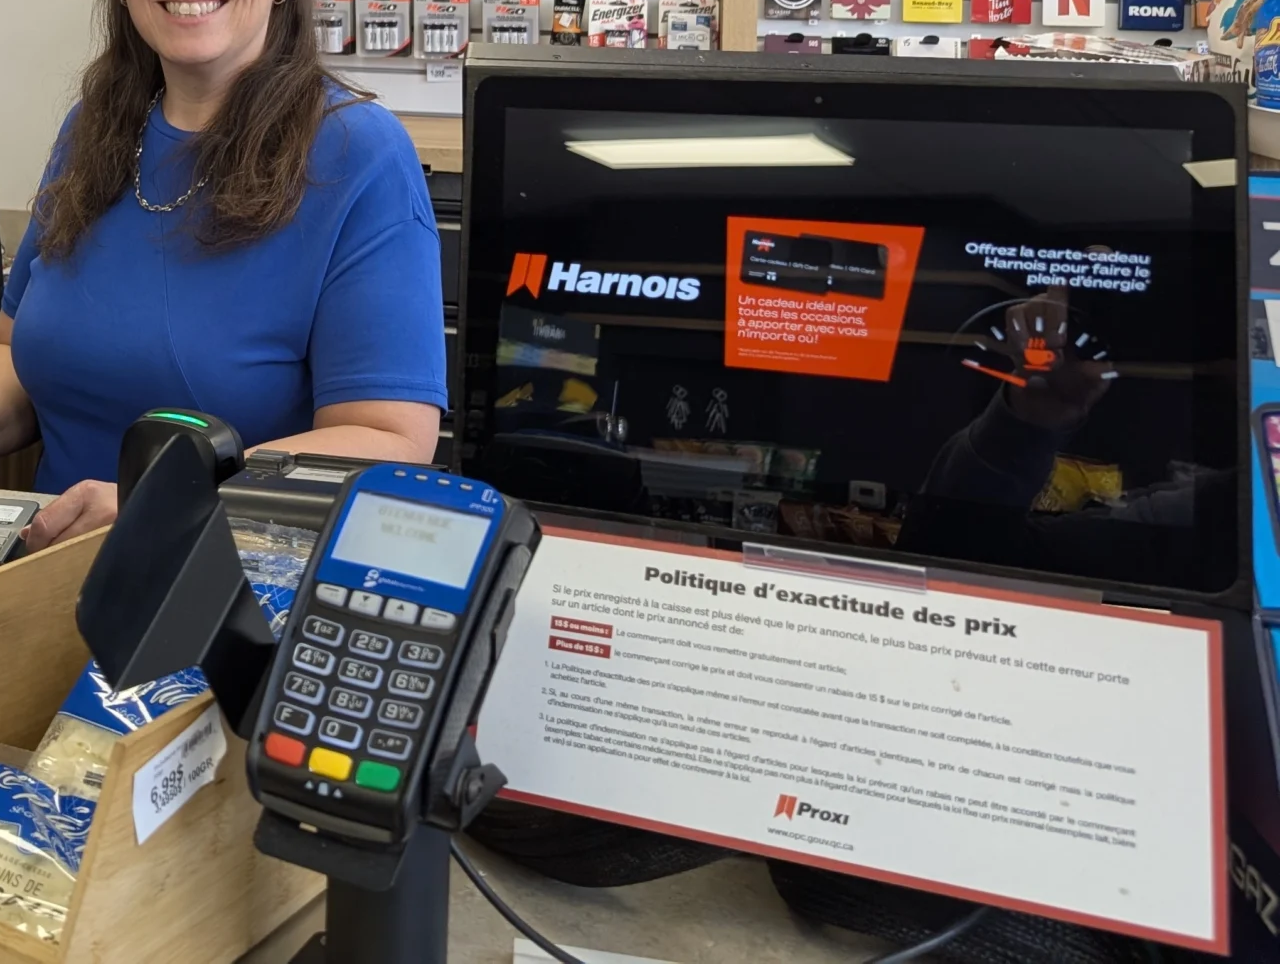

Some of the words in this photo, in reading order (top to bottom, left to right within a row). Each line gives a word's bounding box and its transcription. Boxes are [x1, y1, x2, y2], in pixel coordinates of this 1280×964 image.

[591, 3, 645, 21] Energizer
[1128, 5, 1177, 18] RONA
[965, 242, 1017, 257] Offrez
[1020, 245, 1034, 258] la
[1037, 247, 1152, 265] carte-cadeau
[984, 256, 1047, 271] Harnois
[1049, 261, 1089, 274] pour
[1092, 263, 1132, 277] faire
[1134, 266, 1151, 278] le
[547, 261, 701, 302] Harnois
[1026, 273, 1067, 286] plein
[738, 295, 756, 306] Un
[757, 297, 804, 309] cadeau
[805, 299, 836, 312] idéal
[837, 303, 869, 315] pour
[737, 317, 746, 327] à
[748, 319, 803, 333] apporter
[804, 322, 835, 334] avec
[837, 326, 869, 338] vous
[738, 307, 778, 319] toutes
[781, 309, 799, 321] les
[800, 311, 866, 327] occasions,
[737, 328, 796, 343] n'importe
[644, 566, 746, 596] Politique
[753, 582, 905, 620] d'exactitude
[912, 606, 956, 628] des
[964, 617, 1017, 638] prix
[552, 584, 562, 594] Si
[563, 585, 572, 596] le
[573, 588, 592, 599] prix
[593, 591, 641, 606] enregistré
[643, 598, 649, 607] à
[651, 598, 660, 609] la
[661, 601, 692, 614] caisse
[694, 606, 710, 617] est
[712, 609, 733, 622] plus
[735, 612, 762, 625] élevé
[763, 619, 784, 631] que
[786, 620, 795, 631] le
[797, 622, 818, 635] prix
[819, 626, 868, 643] annoncé,
[870, 633, 880, 645] le
[882, 637, 906, 649] plus
[908, 640, 928, 652] bas
[930, 645, 952, 657] prix
[954, 649, 998, 664] prévaut
[1000, 656, 1011, 666] et
[1014, 658, 1024, 668] si
[1026, 661, 1056, 673] cette
[1058, 666, 1095, 680] erreur
[1097, 672, 1131, 686] porte
[188, 757, 214, 782] 100GR
[796, 801, 850, 826] Proxi
[767, 825, 855, 852] www.opc.gouv.qc.ca
[23, 877, 44, 897] DE
